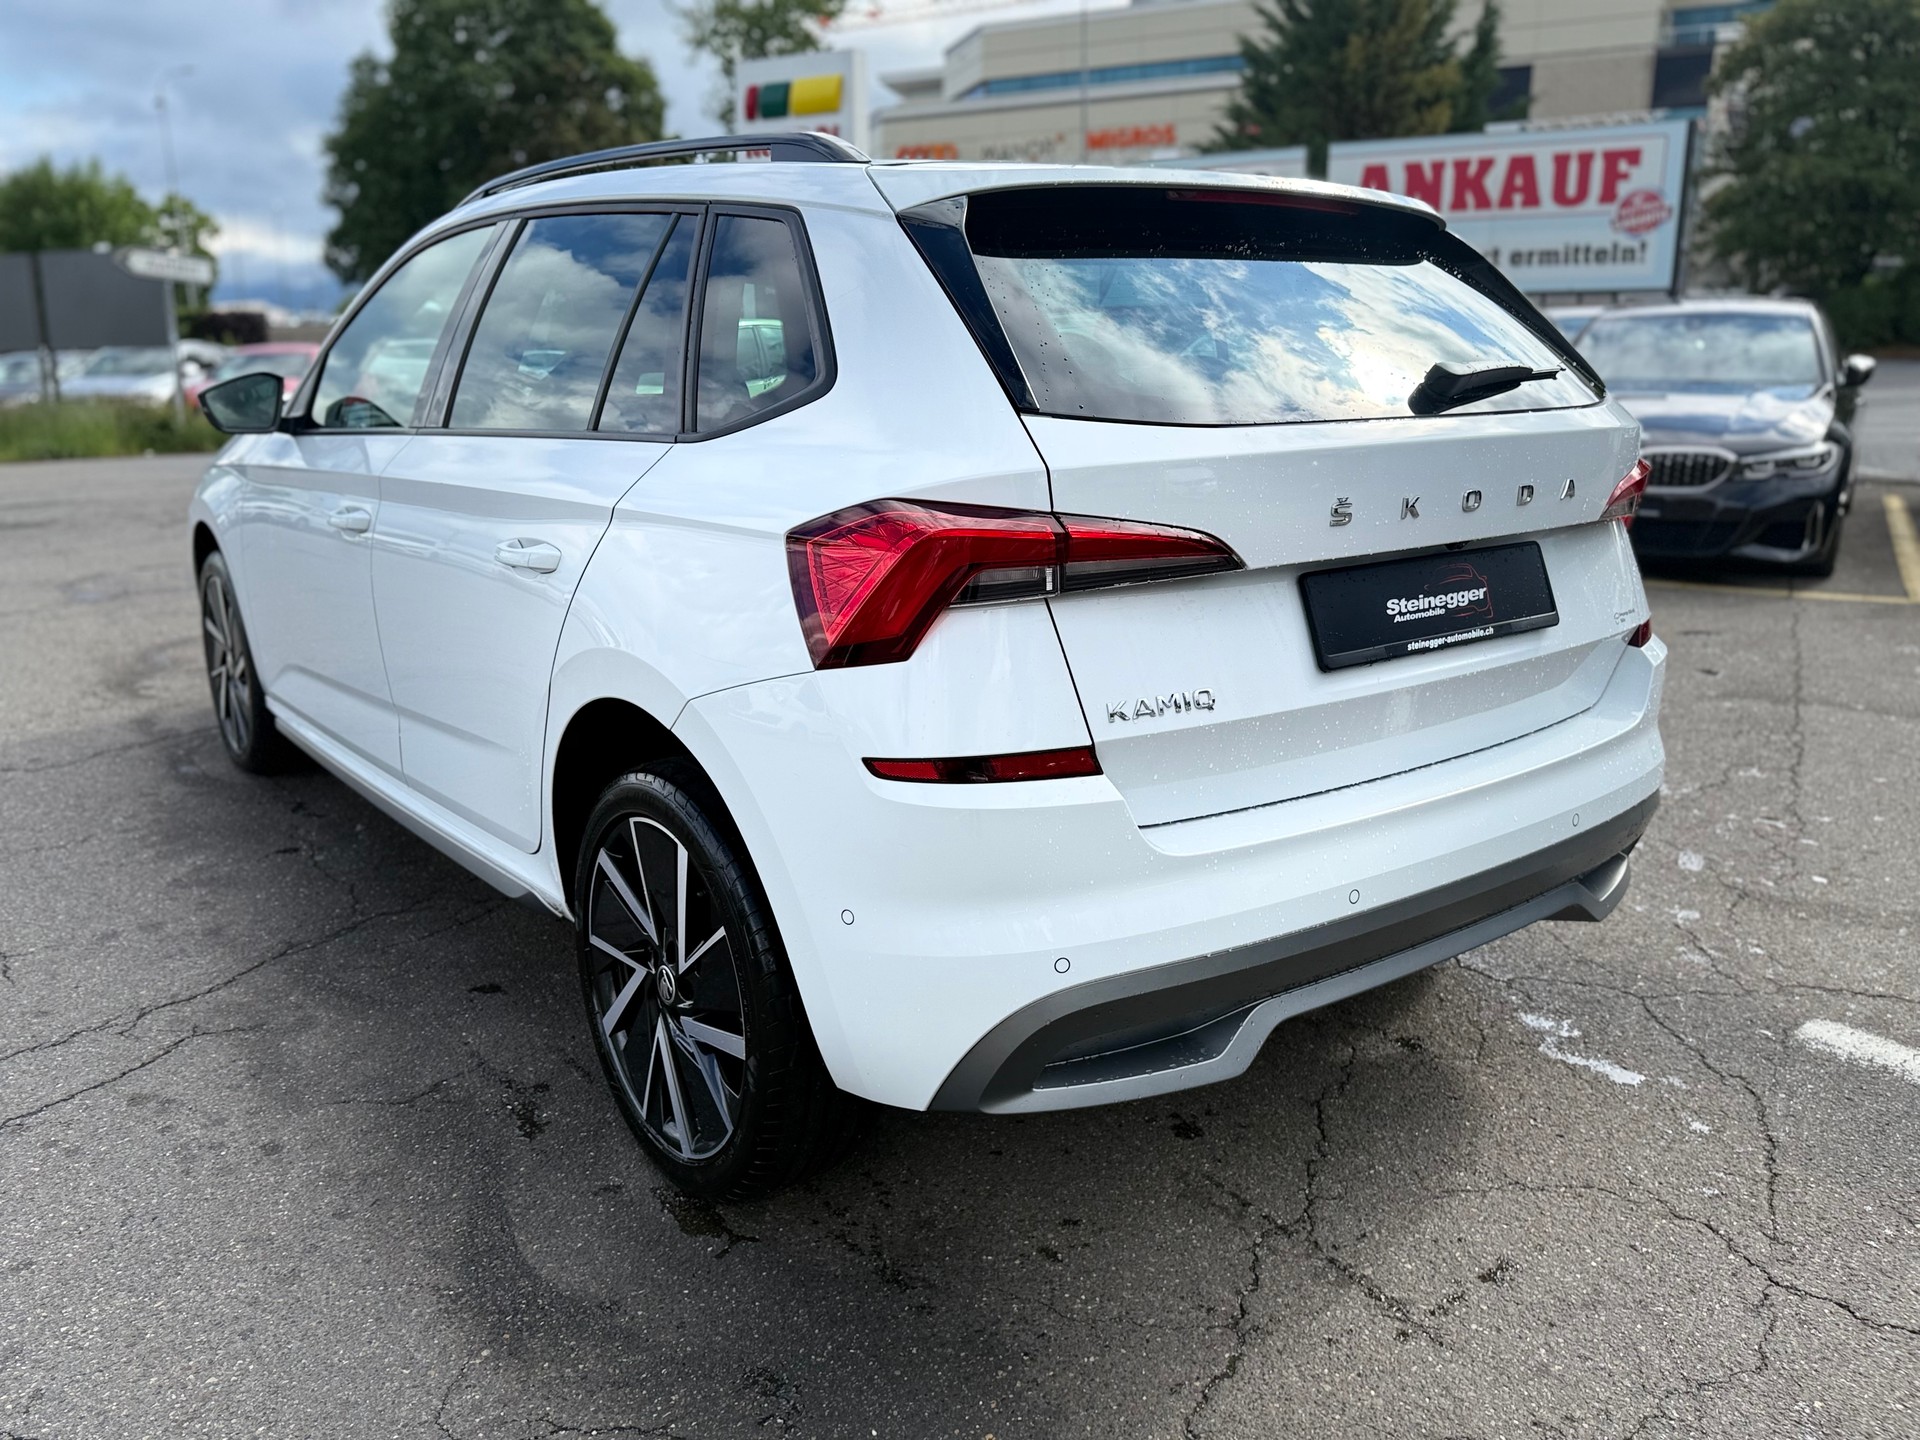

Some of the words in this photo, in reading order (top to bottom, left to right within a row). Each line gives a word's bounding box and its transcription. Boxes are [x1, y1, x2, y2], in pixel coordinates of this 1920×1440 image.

[1087, 124, 1176, 150] MIGROS
[1360, 147, 1642, 213] ANKAUF
[1509, 240, 1646, 267] ermitteln!
[1329, 478, 1576, 527] ŠKODA
[1386, 587, 1487, 615] Steinegger
[1393, 607, 1446, 623] Automobile
[1407, 626, 1494, 651] steinegger-automobile.ch
[1106, 688, 1216, 724] KAMIQ
